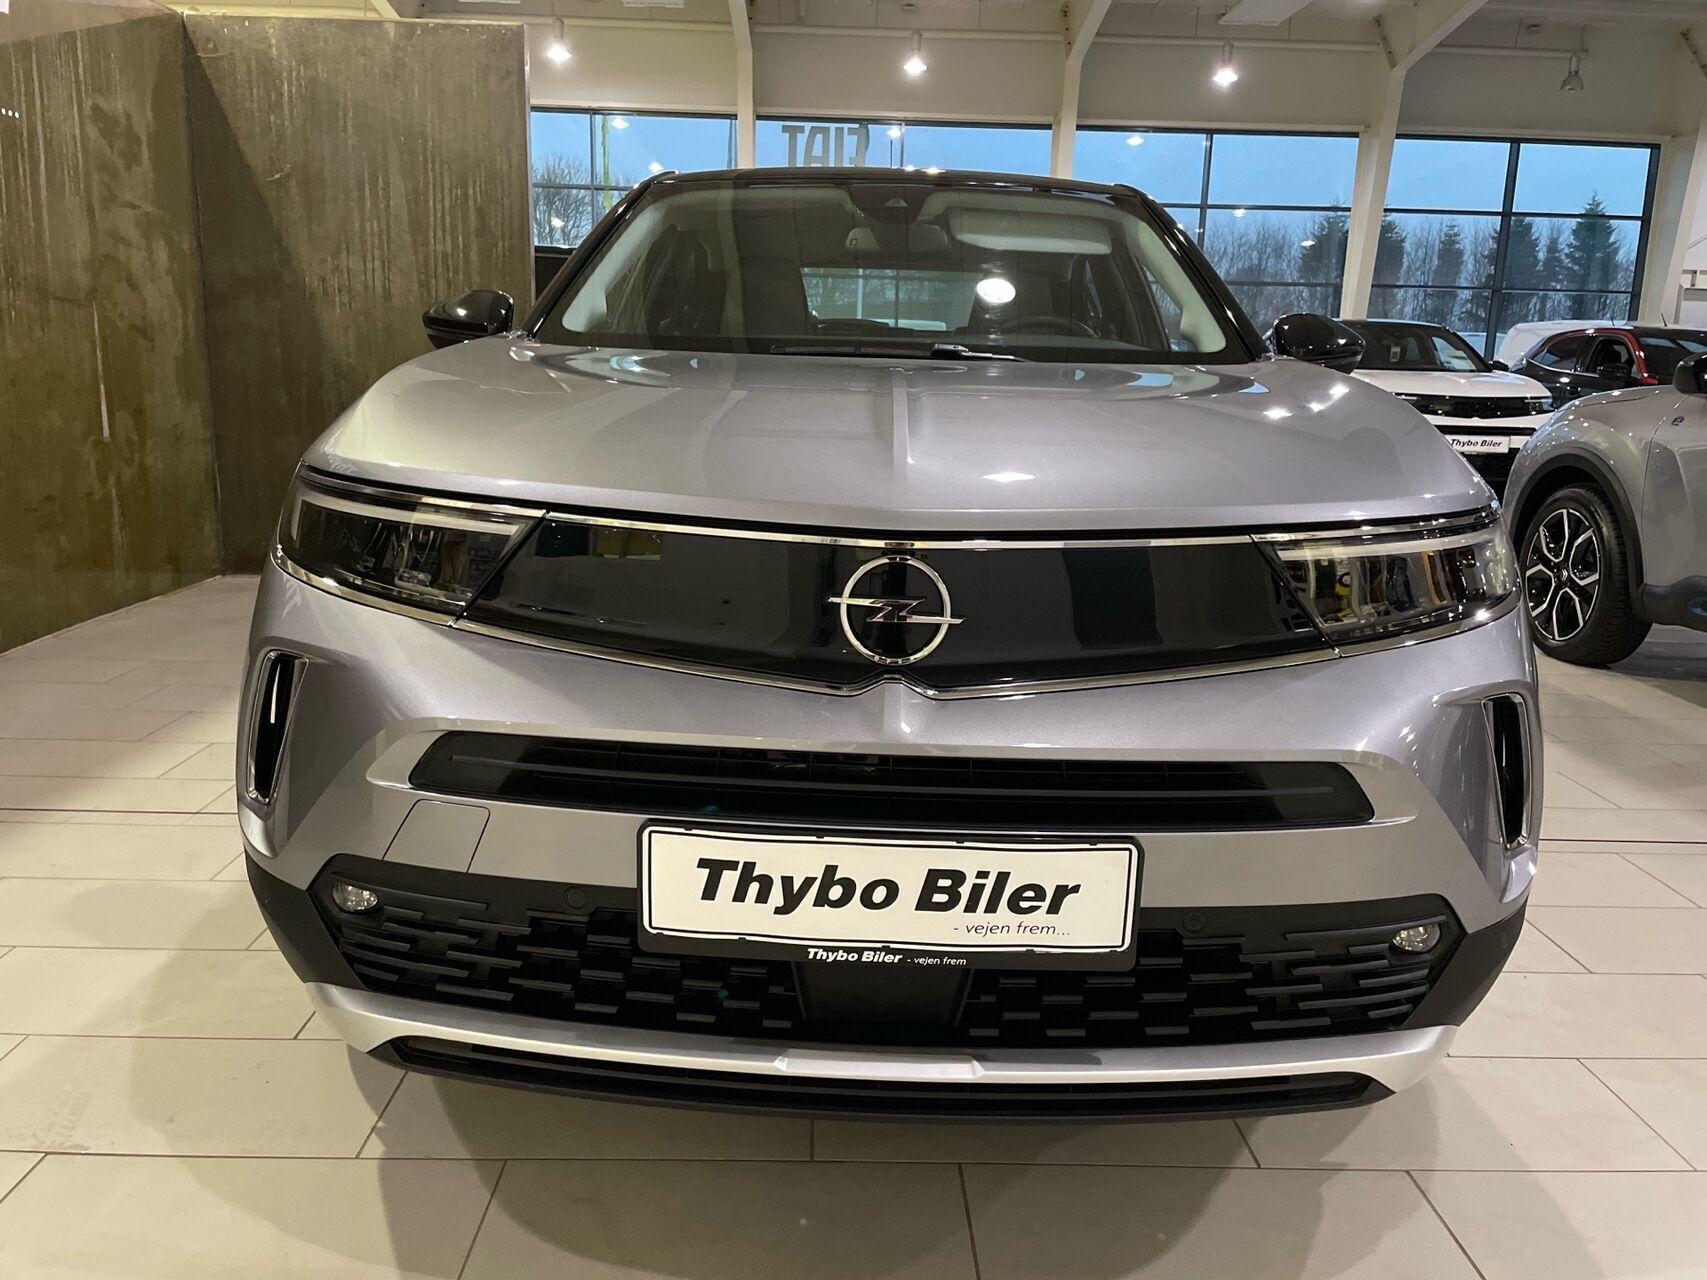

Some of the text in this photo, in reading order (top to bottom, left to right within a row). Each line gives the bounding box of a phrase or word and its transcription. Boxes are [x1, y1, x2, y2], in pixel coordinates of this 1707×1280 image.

[1451, 438, 1478, 447] Thybo
[696, 857, 1081, 916] Thybo Biler
[966, 921, 1011, 937] vejen
[1015, 920, 1071, 936] frem...
[807, 948, 858, 963] Thybo
[861, 951, 903, 964] Biler
[914, 956, 941, 966] vejen
[942, 956, 967, 966] frem
